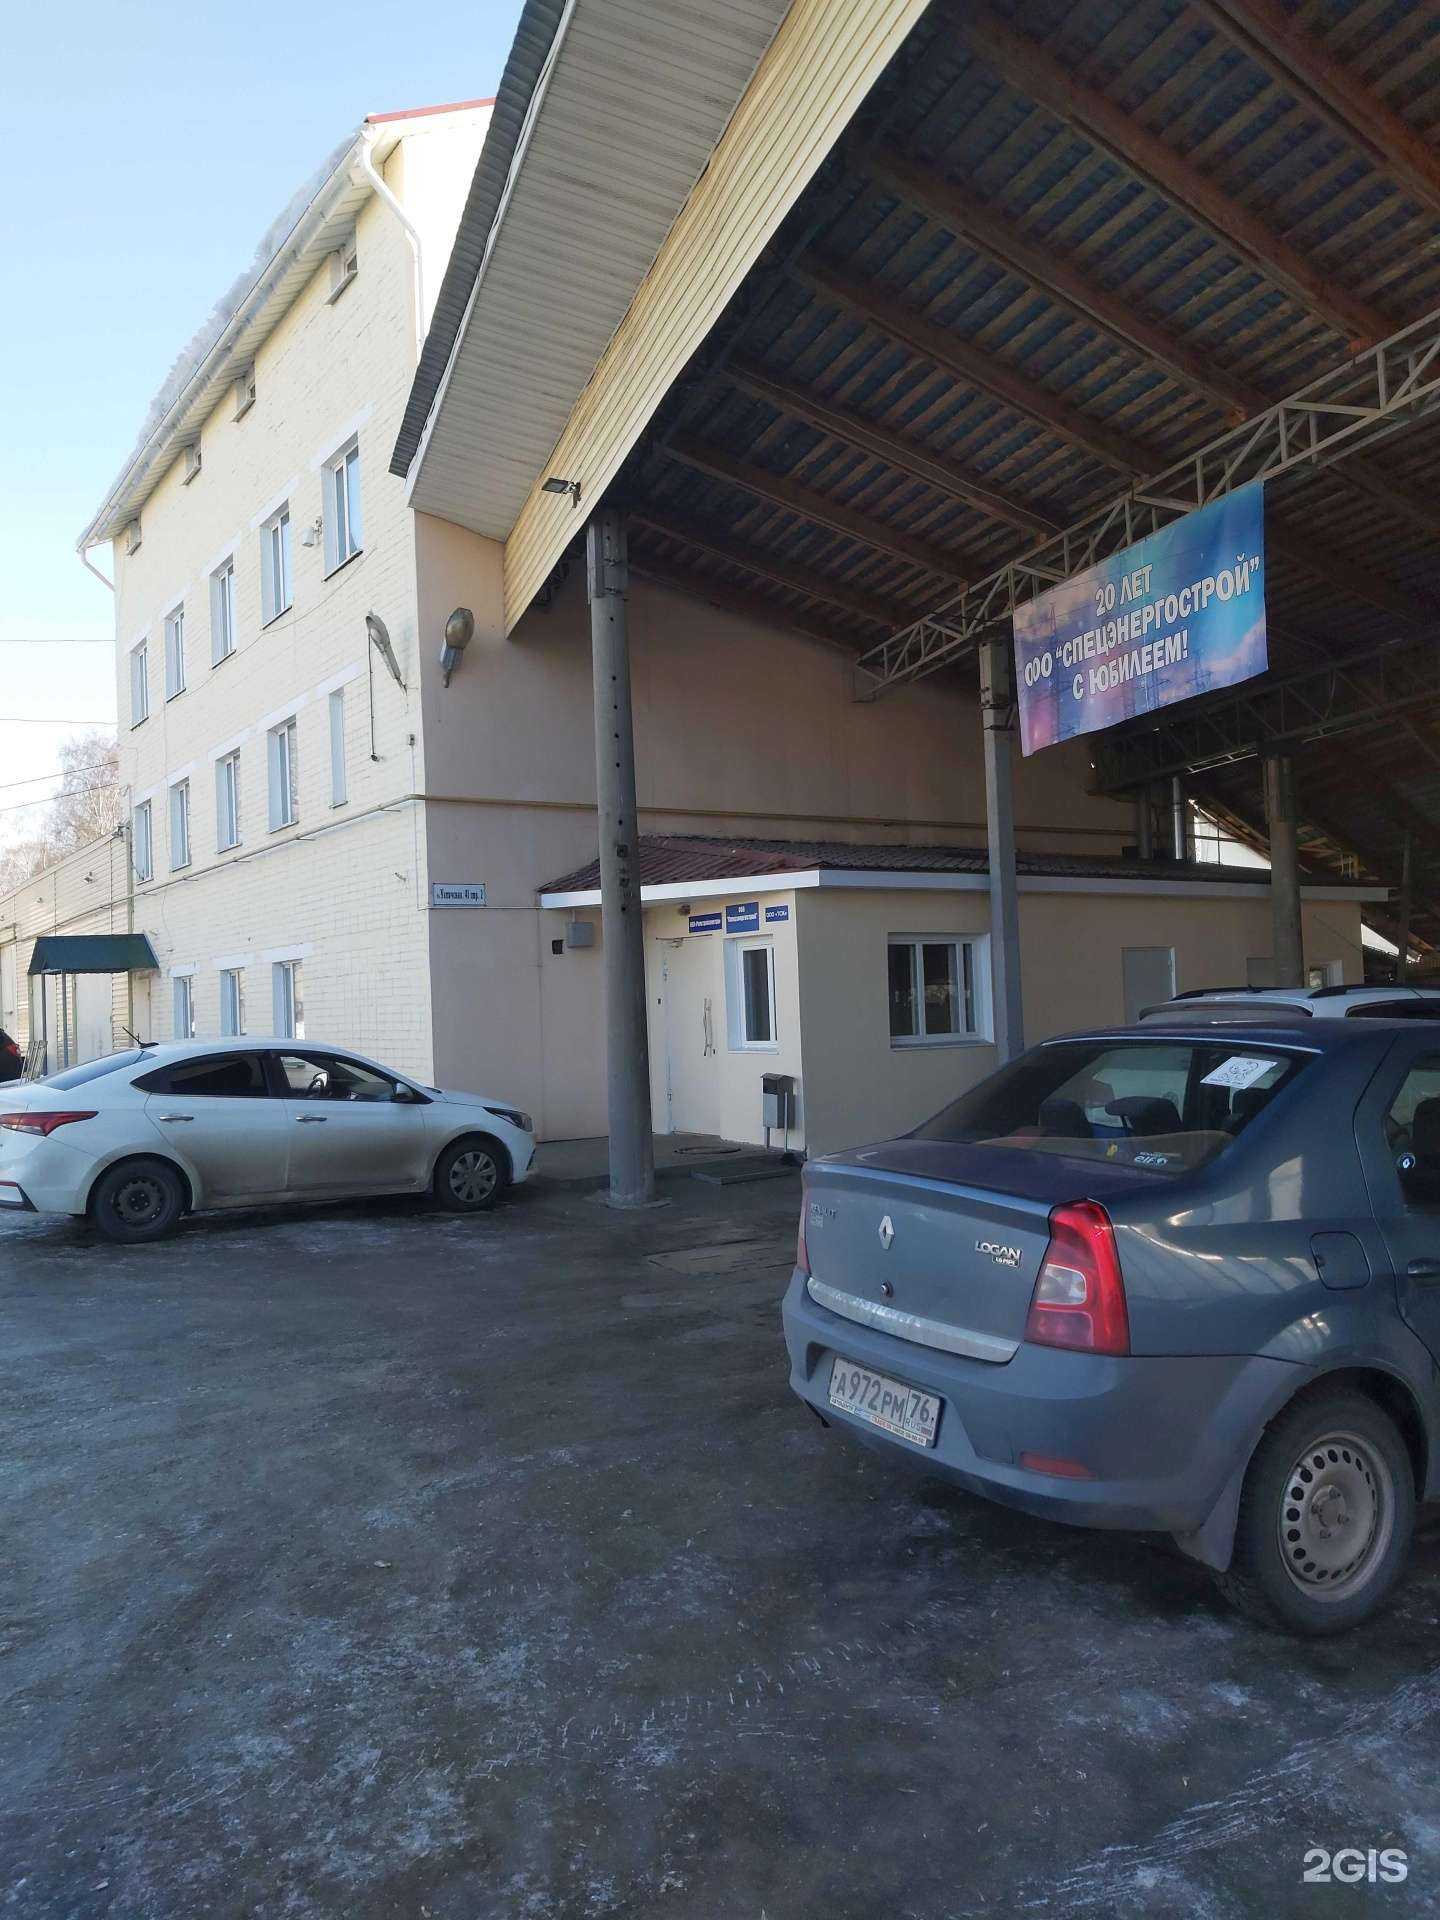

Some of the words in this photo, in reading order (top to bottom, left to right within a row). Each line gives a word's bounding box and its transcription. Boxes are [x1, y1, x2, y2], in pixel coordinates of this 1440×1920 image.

[1095, 583, 1115, 616] 20
[1120, 563, 1153, 605] ЛЕТ
[1024, 652, 1053, 687] ООО
[1072, 673, 1084, 701] С
[1089, 629, 1189, 695] ЮБИЛЕЕМ!
[976, 1240, 1021, 1259] LOGAN
[910, 1393, 930, 1422] 76
